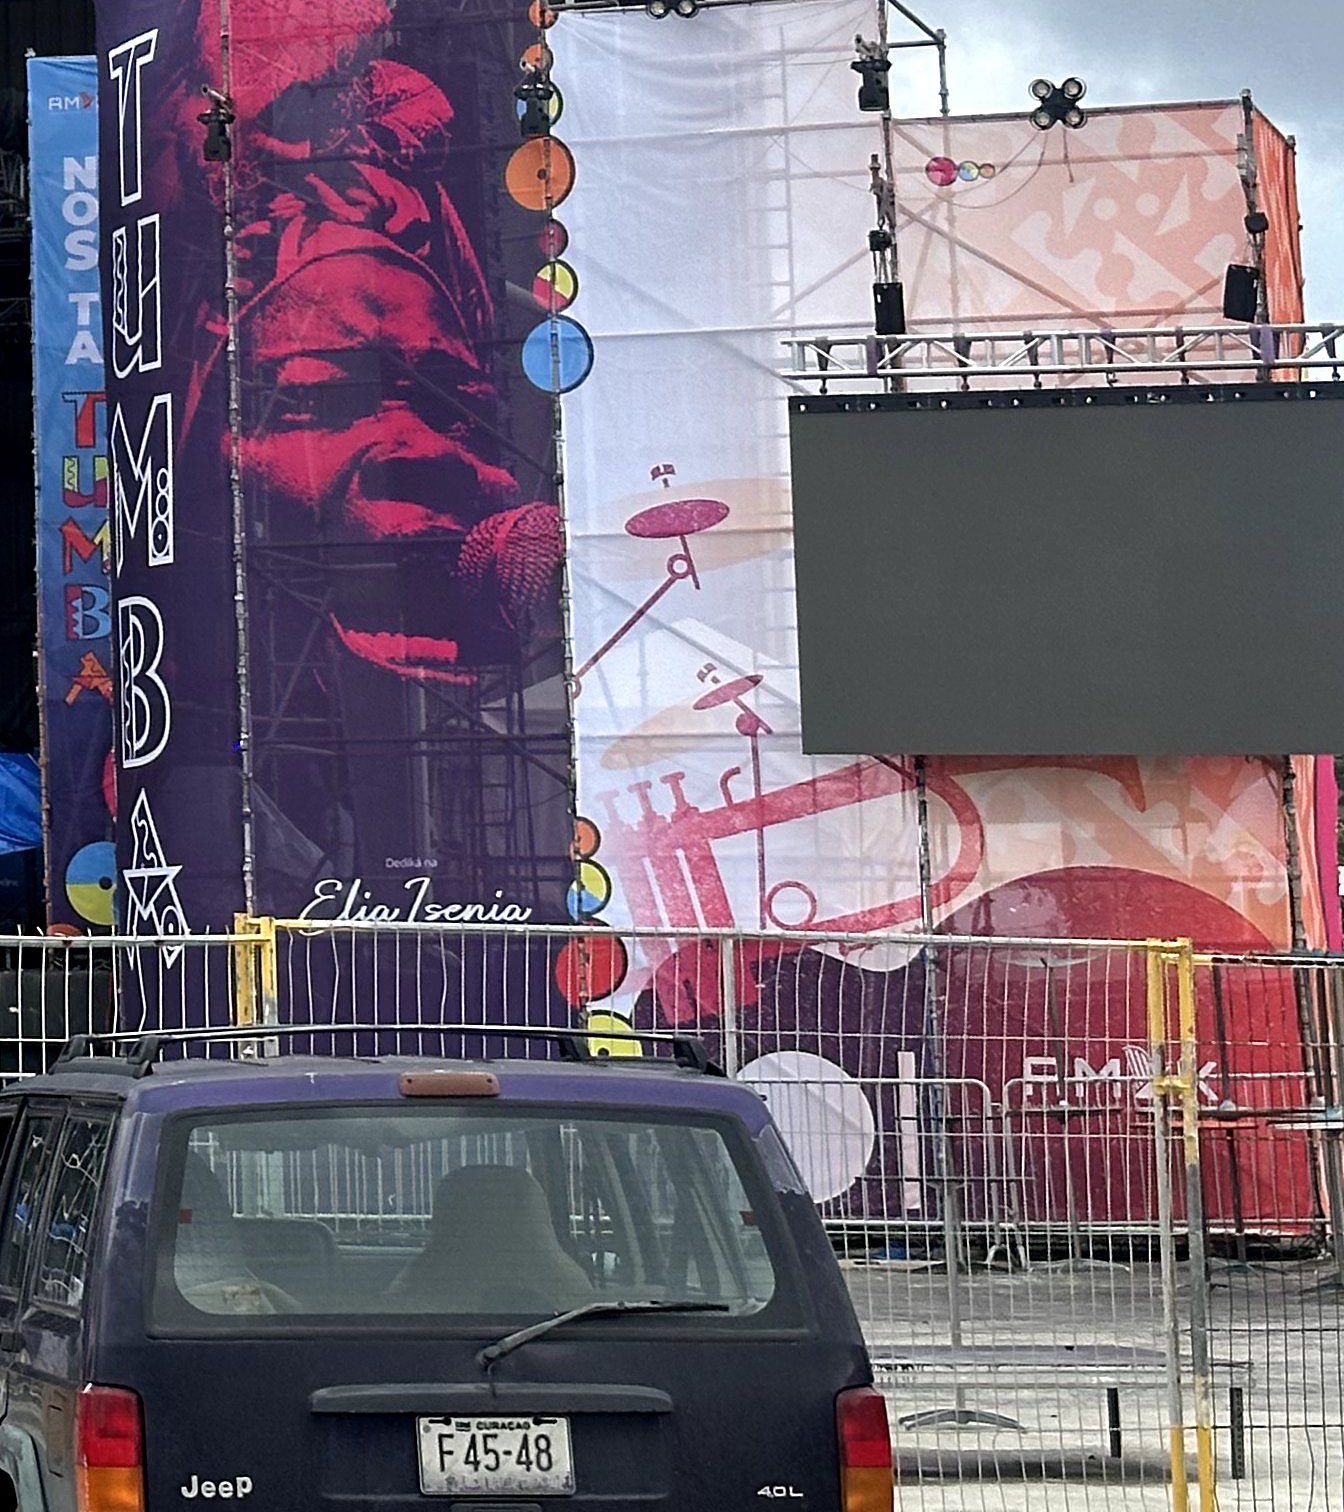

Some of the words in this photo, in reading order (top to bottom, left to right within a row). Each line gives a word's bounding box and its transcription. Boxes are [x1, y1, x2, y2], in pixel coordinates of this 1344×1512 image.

[62, 157, 99, 271] NOS
[64, 292, 104, 365] TA
[108, 28, 182, 969] TUMBA
[62, 391, 113, 706] TUMBA
[423, 859, 438, 868] na
[298, 879, 400, 936] Elia
[404, 877, 533, 922] Isenia
[180, 1475, 253, 1498] Jeep
